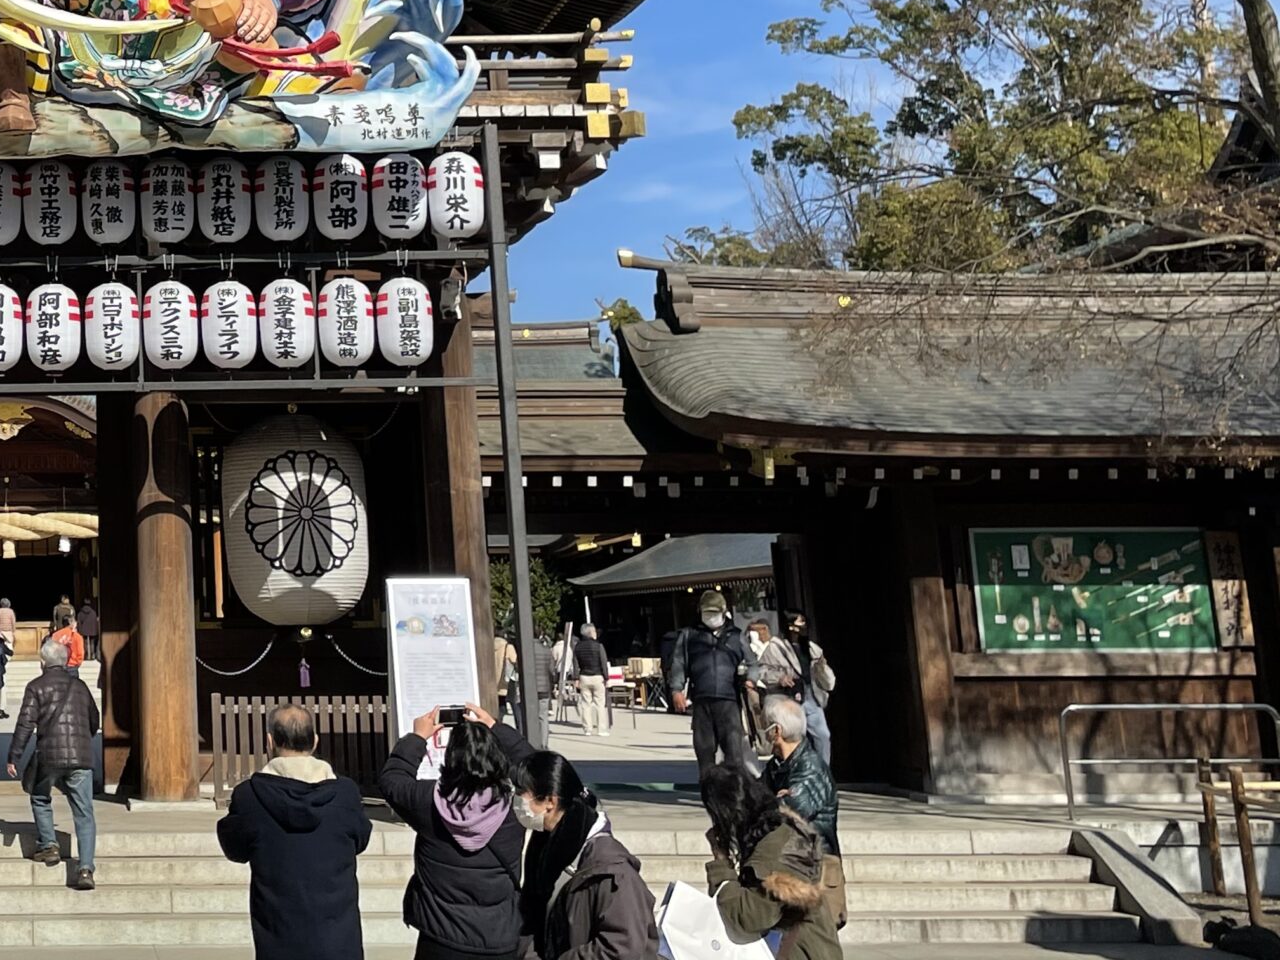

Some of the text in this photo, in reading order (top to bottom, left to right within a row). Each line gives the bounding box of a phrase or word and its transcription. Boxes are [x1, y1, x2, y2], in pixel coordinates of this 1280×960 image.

[38, 163, 63, 238] (株)竹中工務店
[210, 162, 237, 236] (株)丸井紙店
[328, 161, 359, 230] (株)阿部
[387, 161, 410, 230] 田中雄二
[443, 156, 471, 230] 森川栄介
[37, 291, 63, 365] 阿部和彦
[158, 287, 183, 361] (株)テクノス三和
[216, 287, 240, 360] (株)シティライフ
[273, 286, 298, 360] (株)金子建材土木
[335, 283, 359, 359] 熊澤酒造(株)
